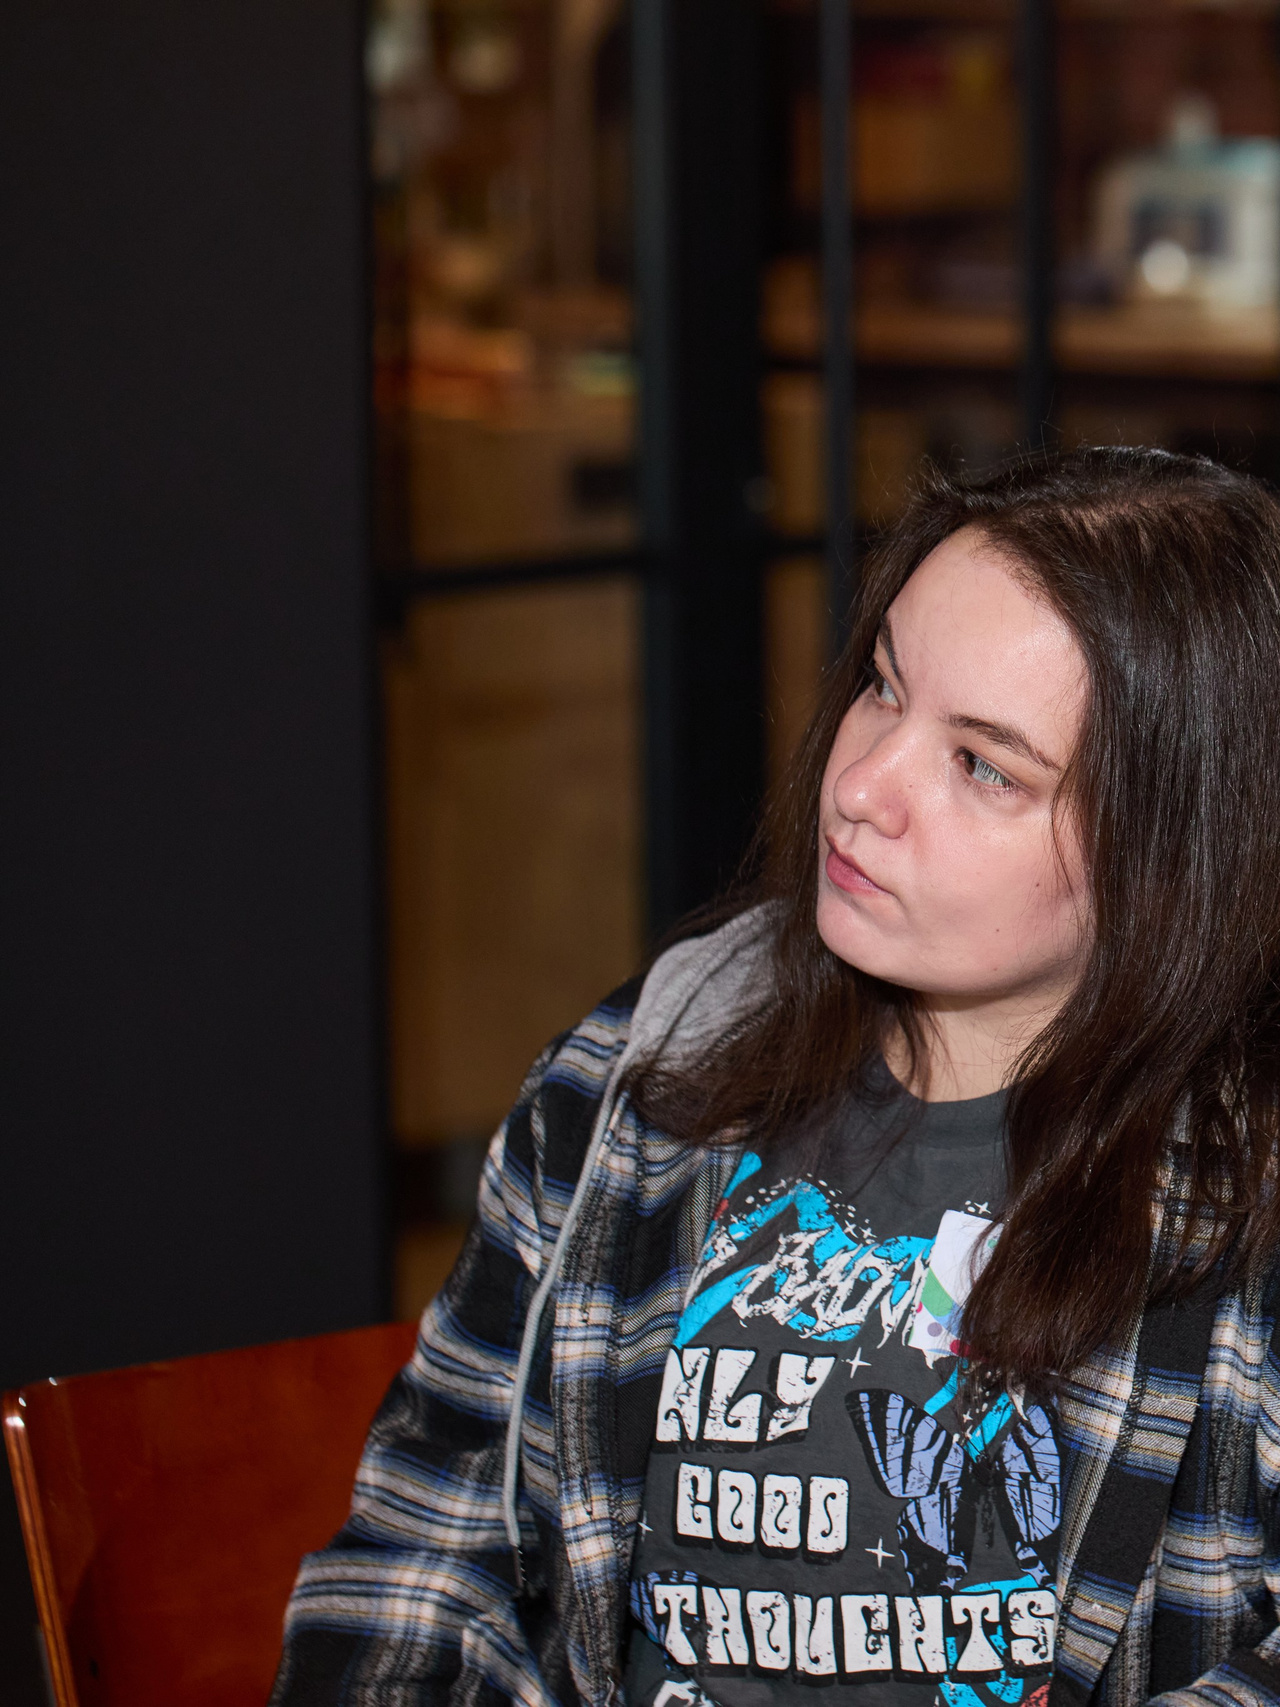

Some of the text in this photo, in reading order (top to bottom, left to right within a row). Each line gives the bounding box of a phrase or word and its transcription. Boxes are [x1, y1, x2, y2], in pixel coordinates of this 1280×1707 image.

[656, 1346, 836, 1442] NLY
[677, 1462, 849, 1553] GOOD
[653, 1584, 1056, 1676] THOUGHTS
